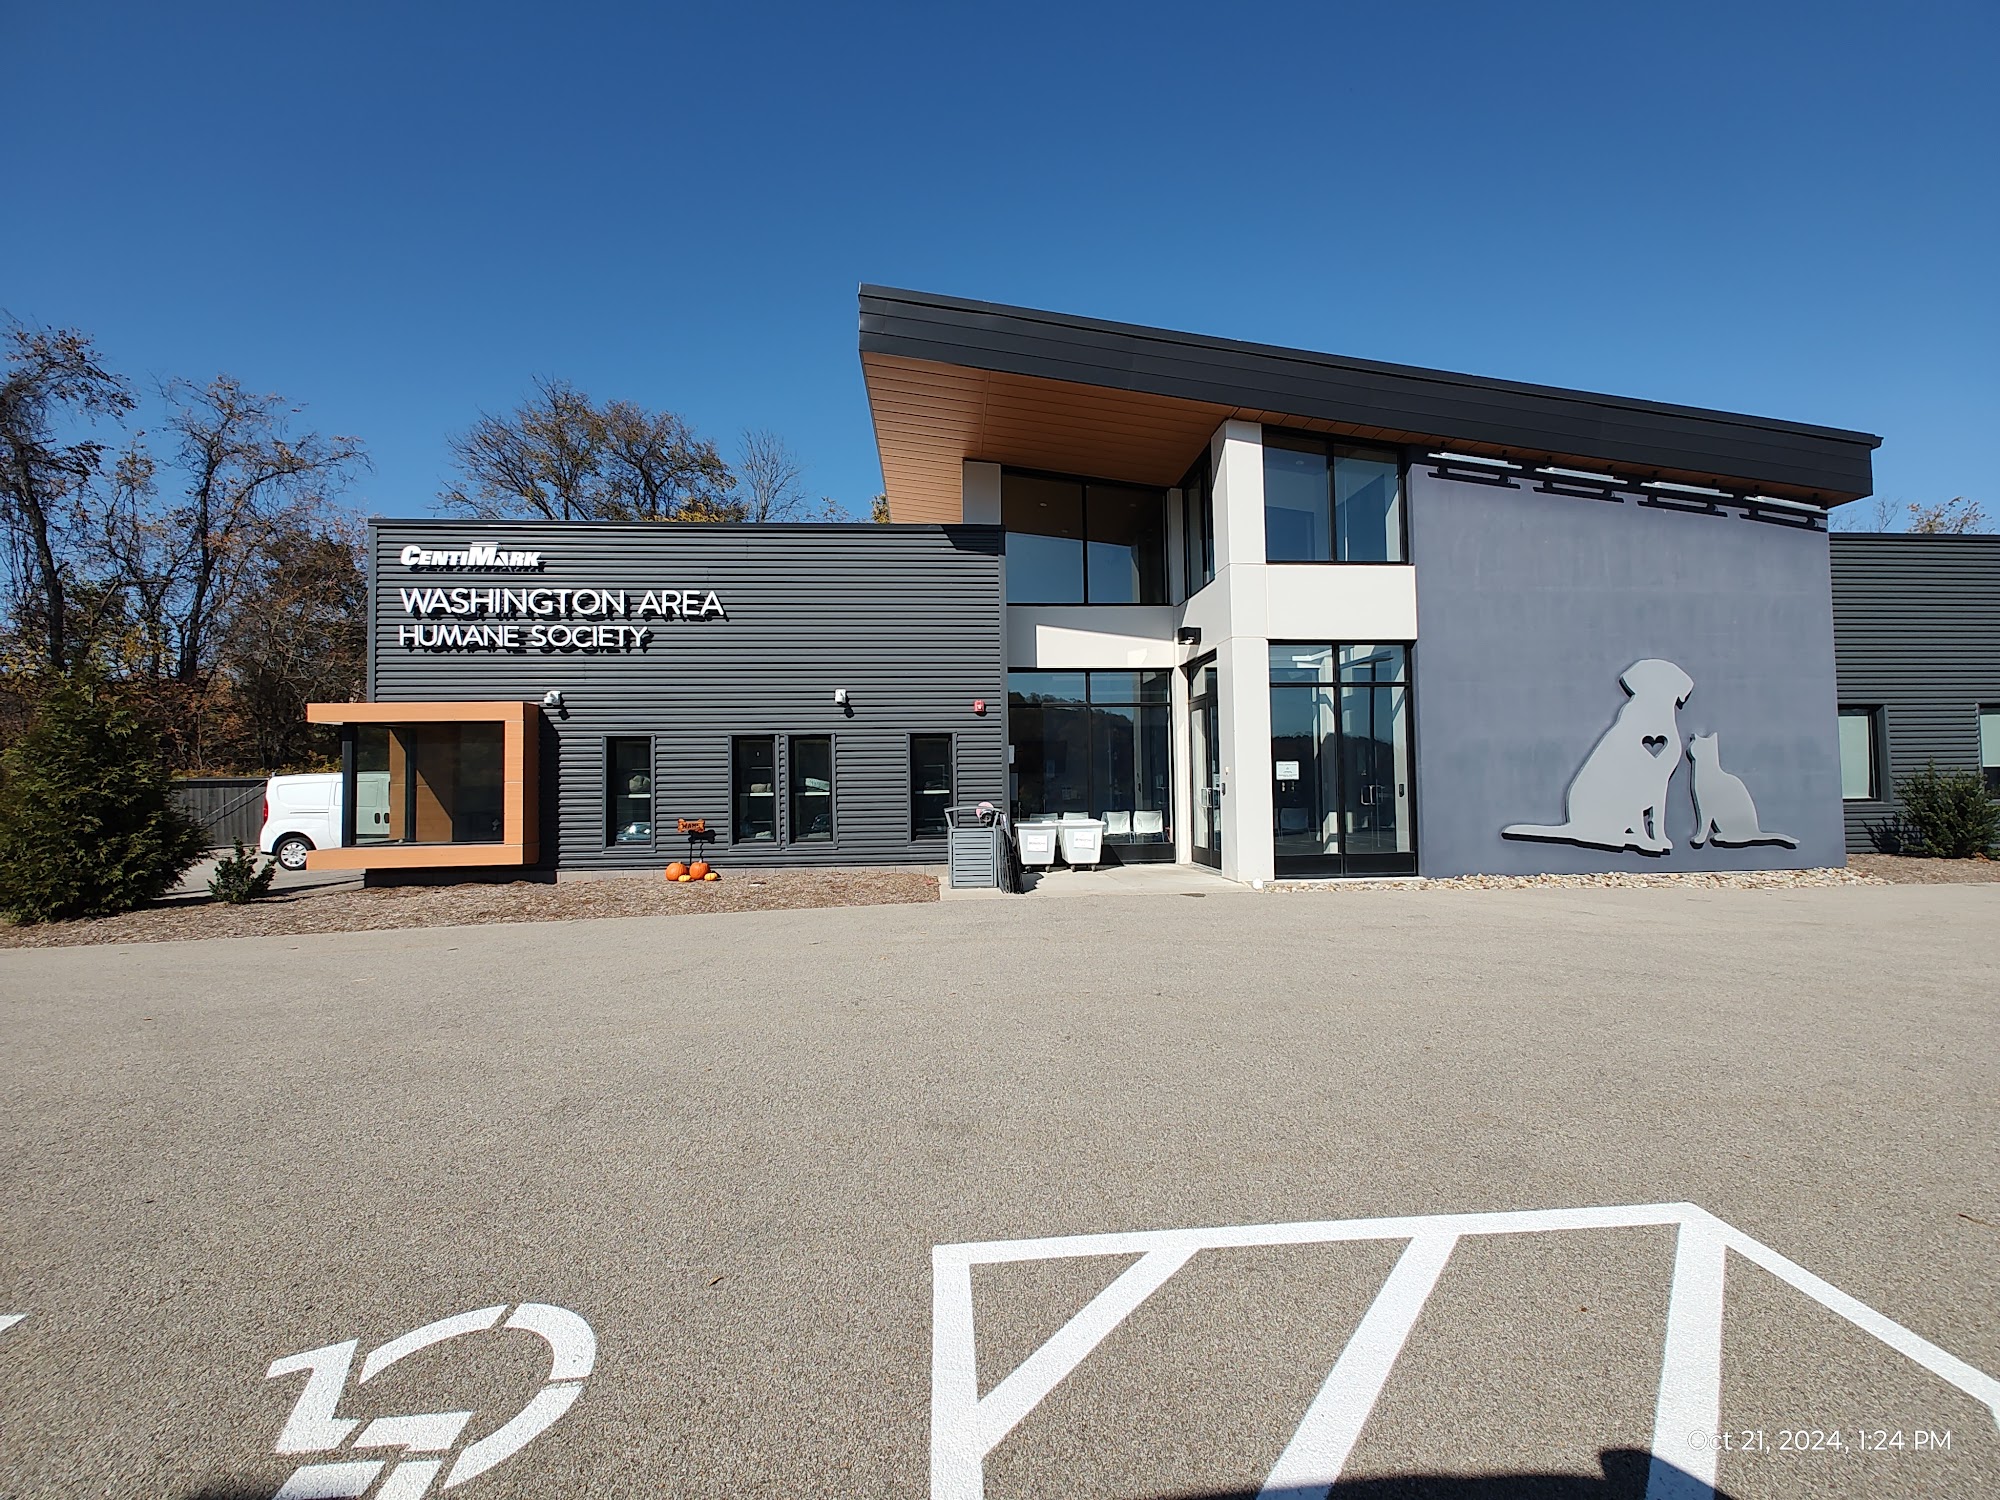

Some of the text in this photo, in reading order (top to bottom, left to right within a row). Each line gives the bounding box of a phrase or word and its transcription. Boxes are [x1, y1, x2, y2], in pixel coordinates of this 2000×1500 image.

[400, 587, 724, 615] WASHINGTON AREA
[399, 624, 648, 647] HUMANE SOCIETY
